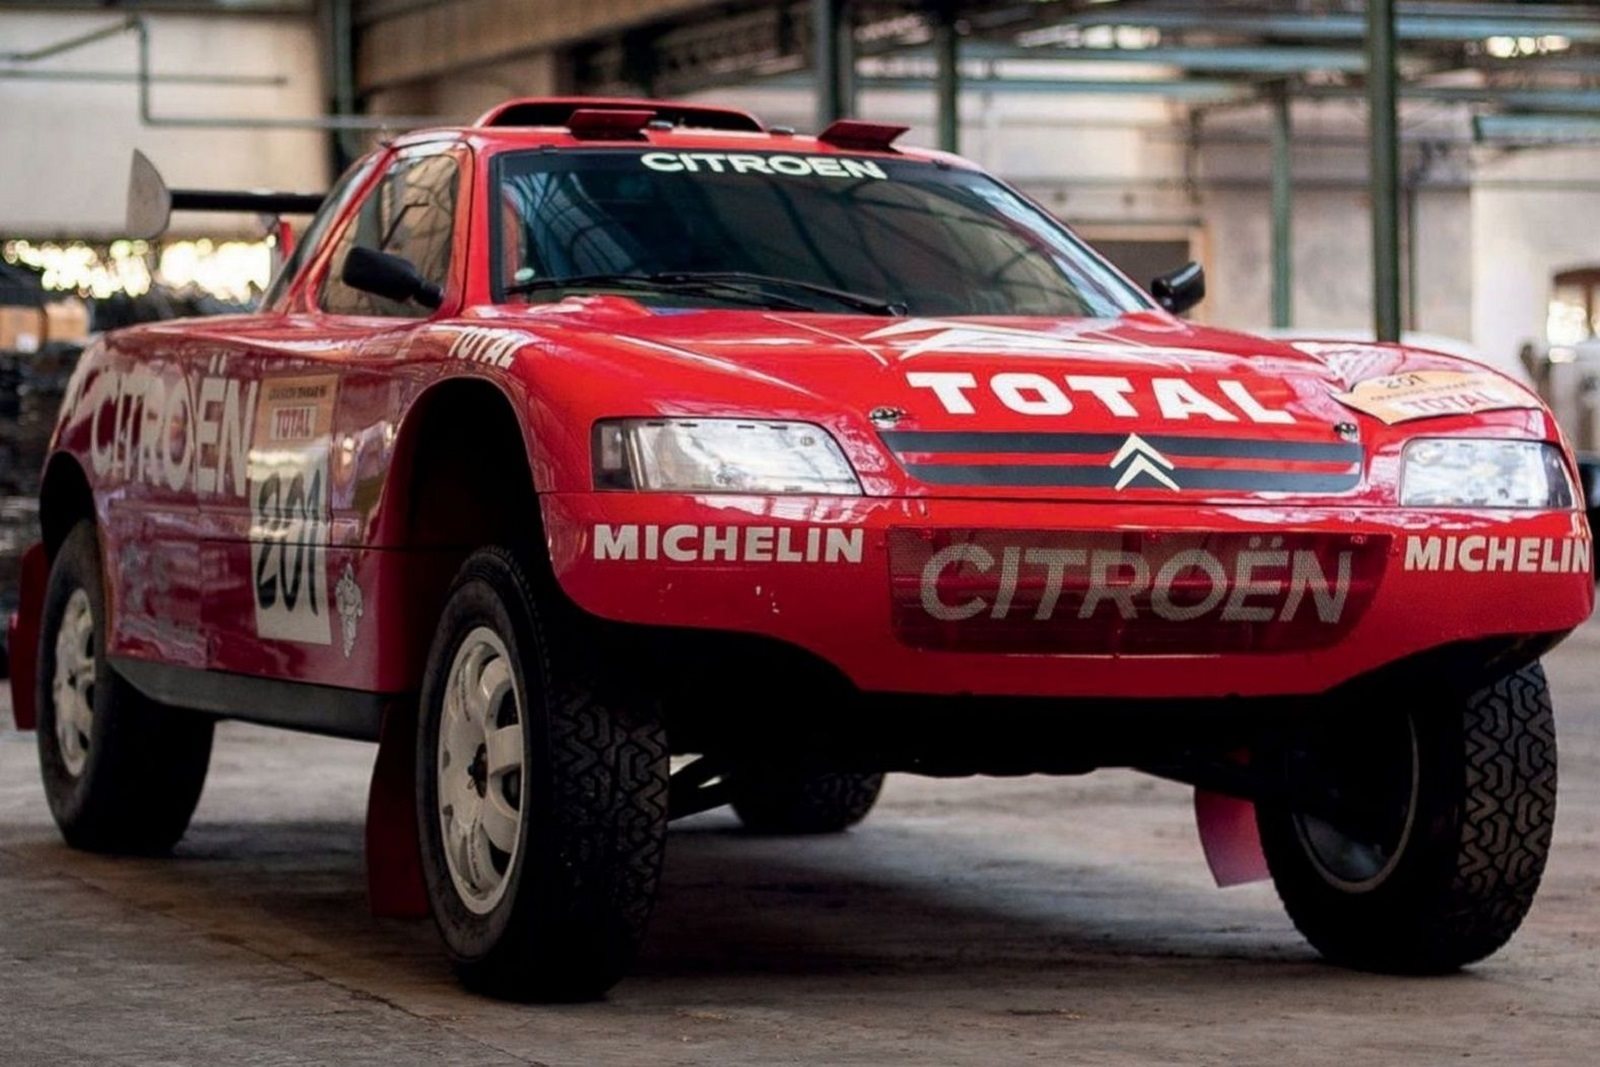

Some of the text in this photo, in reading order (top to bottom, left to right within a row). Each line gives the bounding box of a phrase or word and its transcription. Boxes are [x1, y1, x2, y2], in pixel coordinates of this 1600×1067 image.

[640, 152, 888, 180] CITROEN
[447, 326, 522, 370] TOTAL
[906, 372, 1297, 425] TOTAL
[1402, 391, 1503, 412] TOTAL
[90, 354, 258, 497] CITROËN
[276, 408, 311, 437] TOTAL
[593, 525, 864, 564] MICHELIN
[1404, 536, 1590, 573] MICHELIN
[920, 536, 1352, 624] CITROËN
